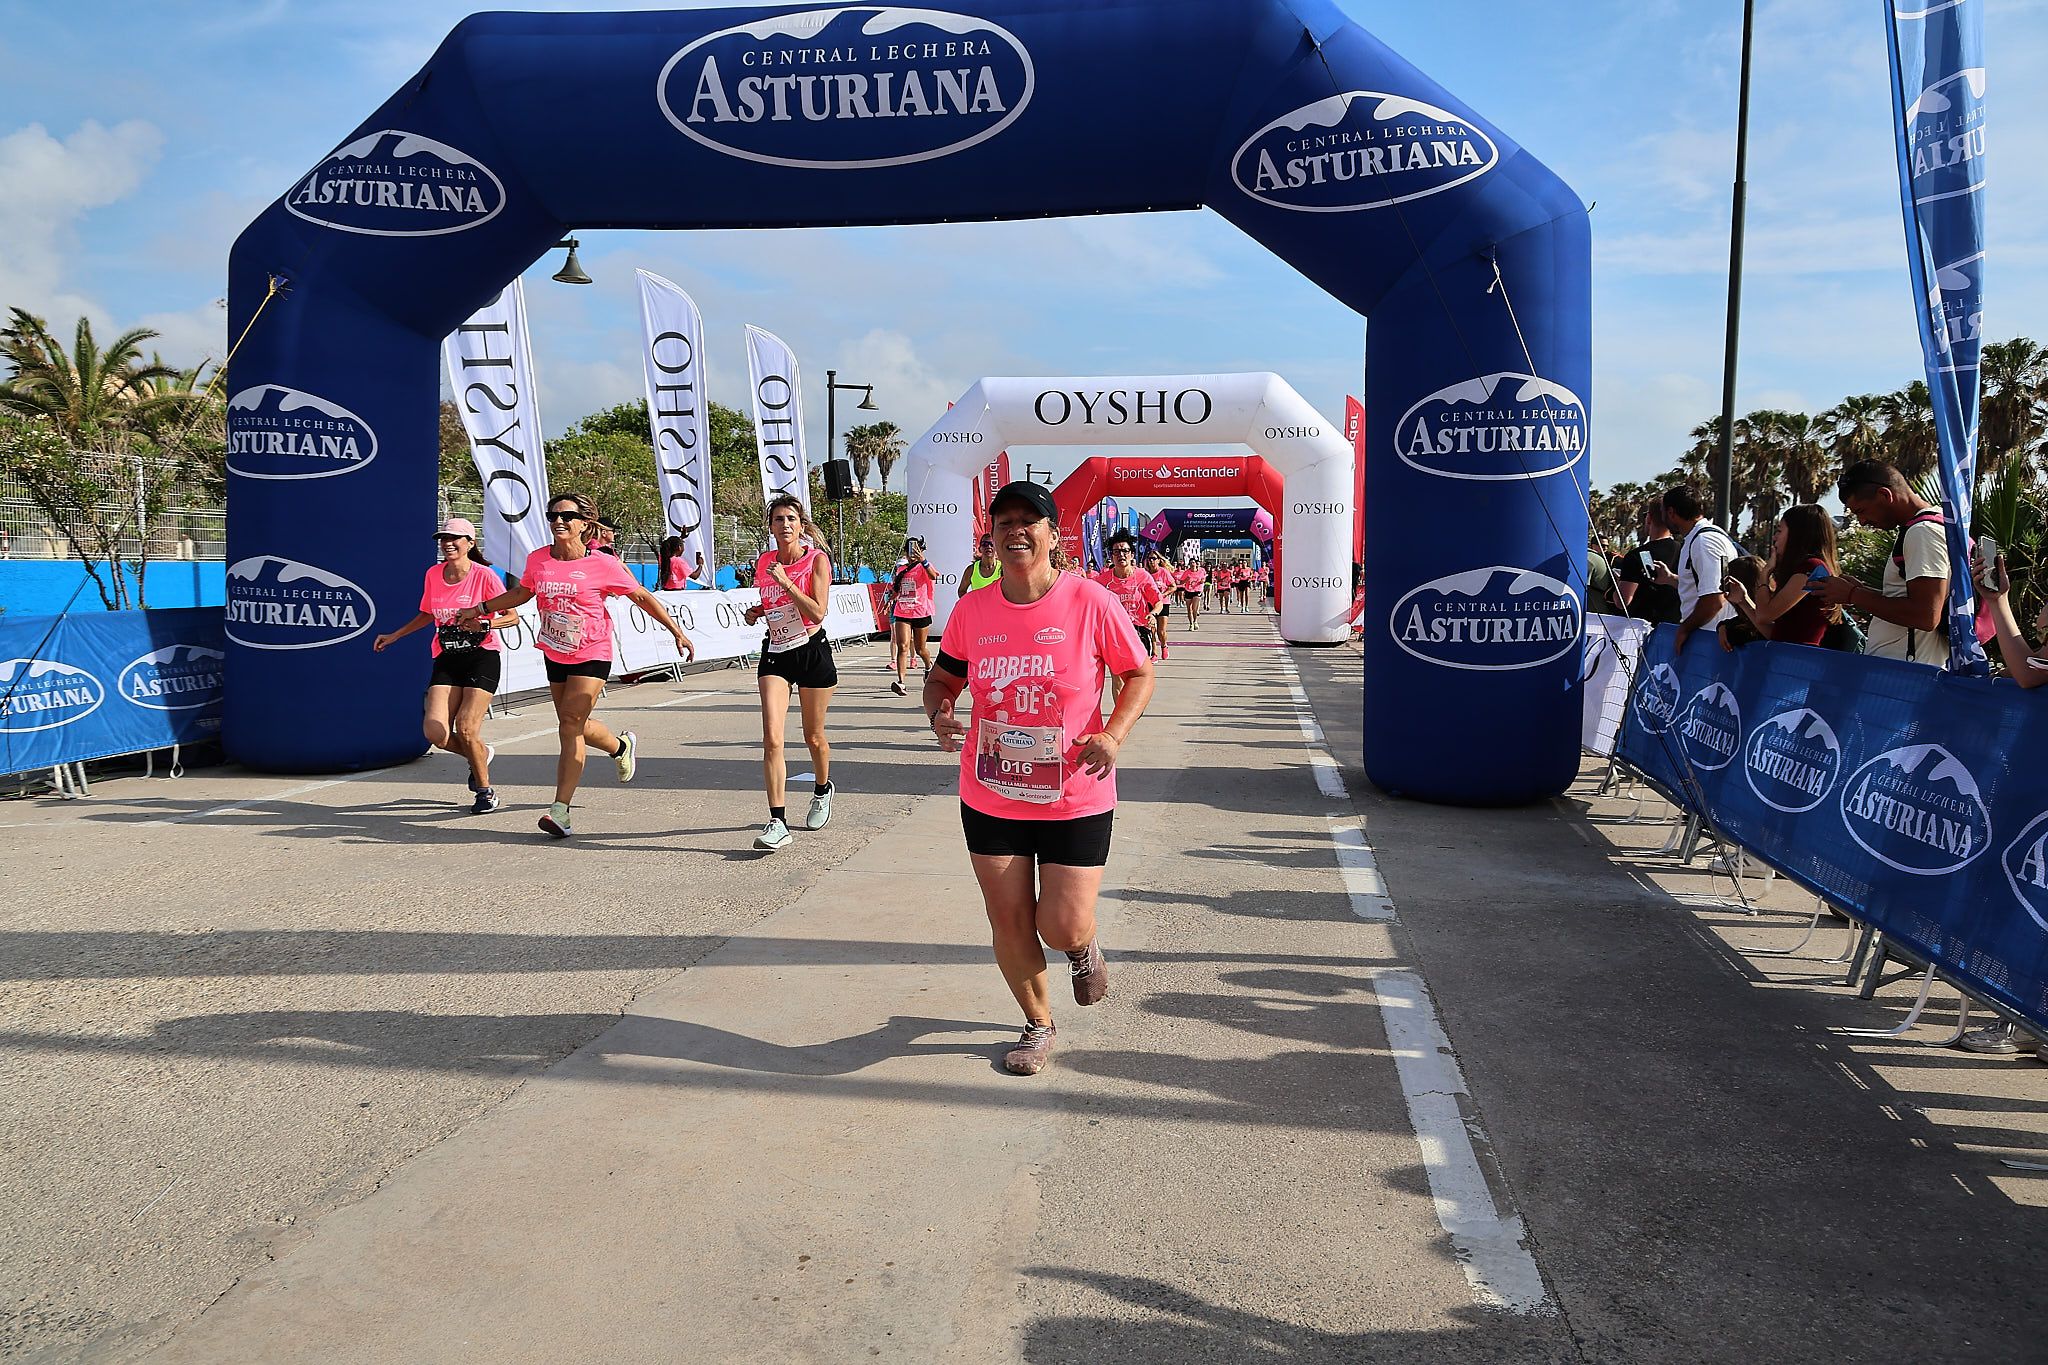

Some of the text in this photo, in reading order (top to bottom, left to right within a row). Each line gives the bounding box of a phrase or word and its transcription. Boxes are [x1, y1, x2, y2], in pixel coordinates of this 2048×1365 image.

[743, 40, 992, 66] CENTRAL LECHERA
[687, 55, 1006, 123] ASTURIANA
[1287, 125, 1467, 152] CENTRAL LECHERA
[328, 164, 477, 181] CENTRAL LECHERA
[1254, 140, 1484, 192] ASTURIANA
[292, 172, 488, 213] ASTURIANA
[1034, 388, 1213, 426] OYSHO
[1440, 409, 1578, 422] CENTRAL LECHERA
[232, 417, 354, 432] CENTRAL LECHERA
[932, 432, 984, 444] OYSHO
[1264, 426, 1320, 440] OYSHO
[1406, 416, 1581, 456] ASTURIANA
[1113, 465, 1240, 482] Sports Santander
[911, 503, 958, 515] OYSHO
[1293, 502, 1344, 515] OYSHO
[537, 581, 577, 595] CARRERA
[1291, 576, 1343, 589] OYSHO
[232, 586, 352, 600] CENTRAL LECHERA
[1434, 600, 1572, 612] CENTRAL LECHERA
[1402, 604, 1574, 643] ASTURIANA
[551, 628, 566, 638] 016
[772, 627, 788, 637] 016
[978, 634, 1007, 646] OYSHO
[445, 640, 471, 650] FILA
[978, 654, 1055, 679] CARRERA
[38, 677, 85, 689] LECHERA
[1680, 705, 1735, 757] ASTURIANA
[1769, 735, 1833, 766] CENTRAL LECHERA
[1001, 760, 1033, 775] 016
[1748, 733, 1827, 797] ASTURIANA
[1877, 774, 1973, 817] CENTRAL LECHERA
[1845, 772, 1972, 859] ASTURIANA
